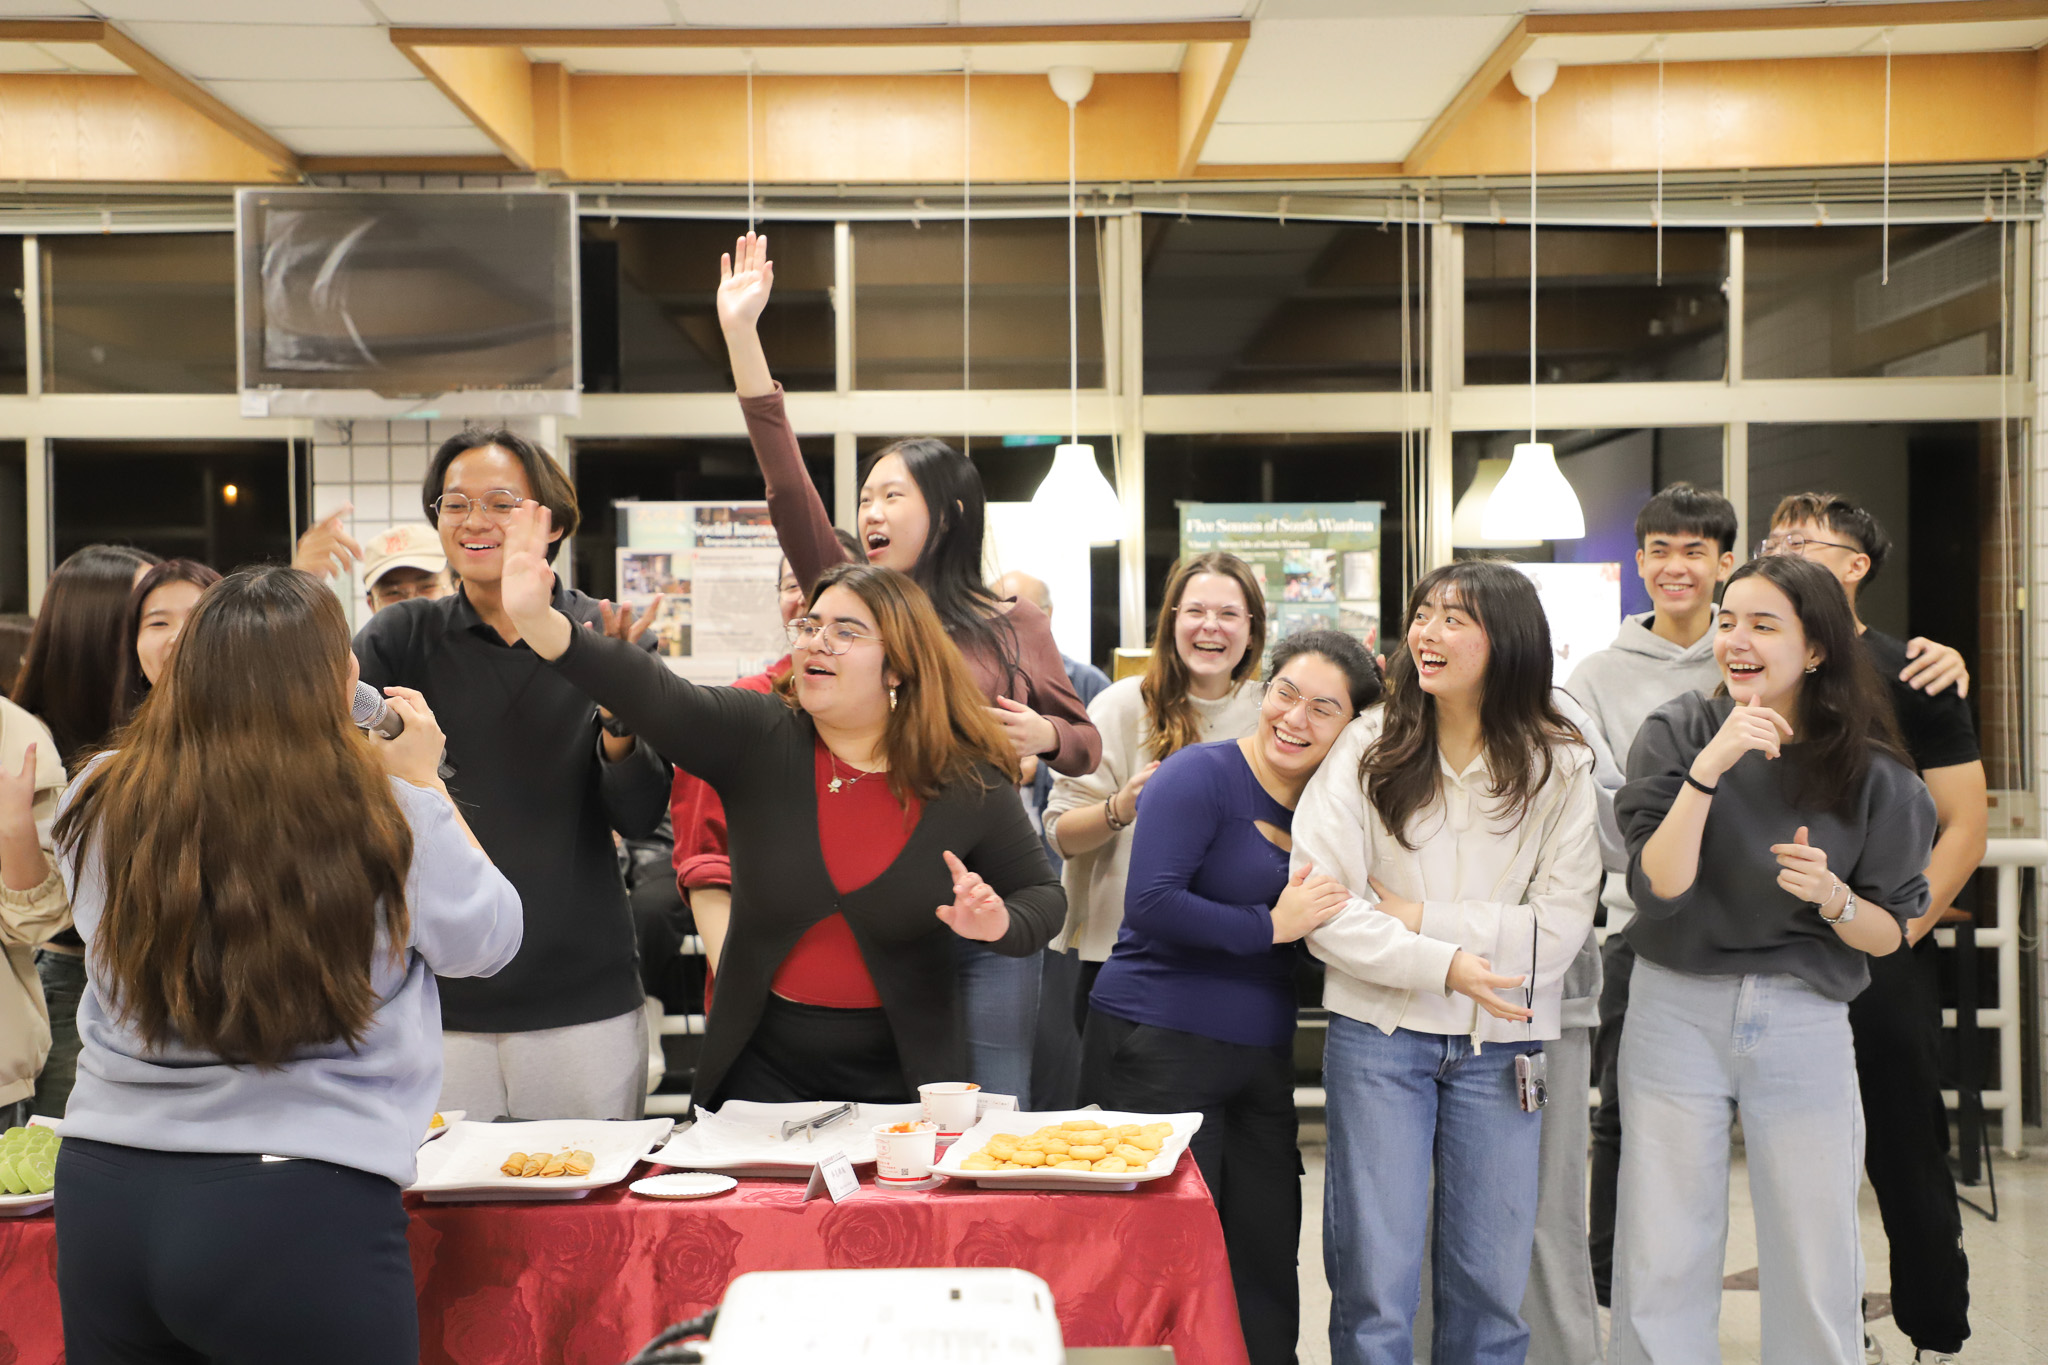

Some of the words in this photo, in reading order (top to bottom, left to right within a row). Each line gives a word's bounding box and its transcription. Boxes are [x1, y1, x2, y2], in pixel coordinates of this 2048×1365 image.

[1186, 518, 1215, 532] Five
[1215, 518, 1263, 532] Senses
[1264, 518, 1279, 532] of
[1279, 518, 1317, 532] South
